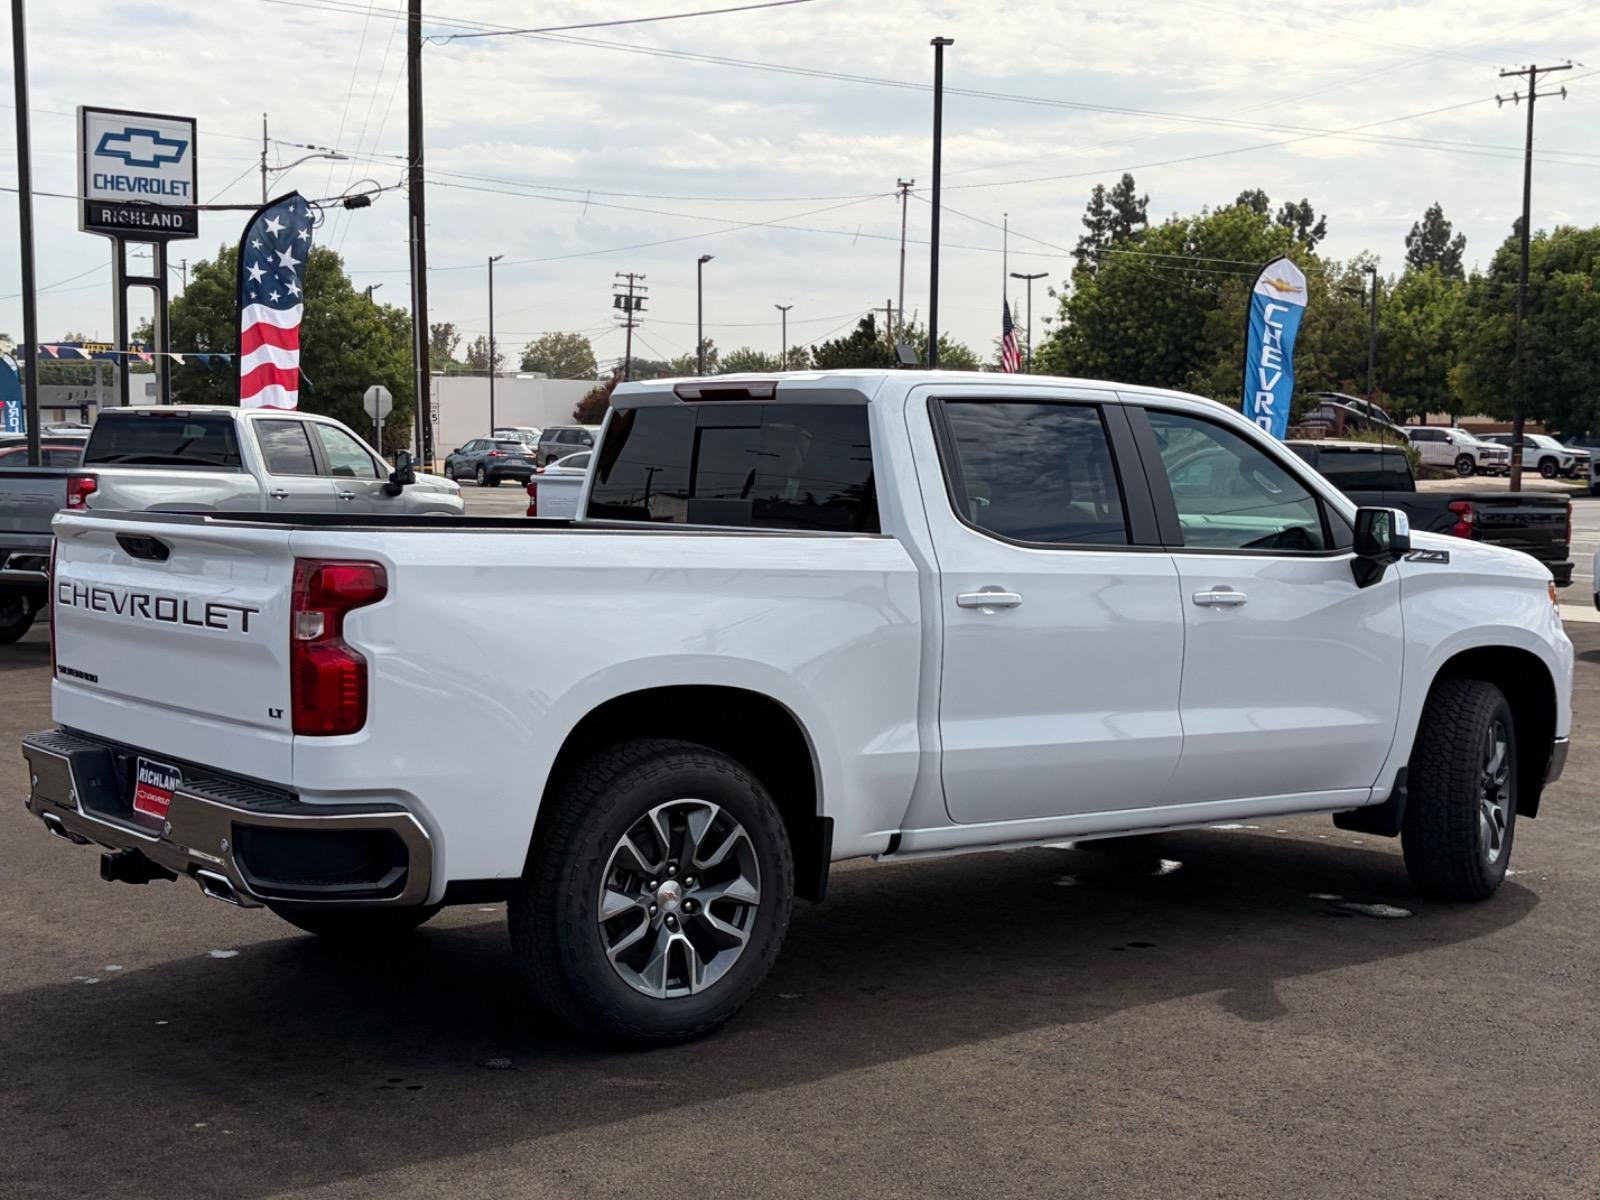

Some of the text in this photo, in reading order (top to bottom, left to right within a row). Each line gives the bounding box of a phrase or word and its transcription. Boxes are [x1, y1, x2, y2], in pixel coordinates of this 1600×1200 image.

[94, 173, 190, 196] CHEVROLET
[101, 209, 183, 228] RICHLAND
[58, 582, 260, 632] CHEVROLET
[268, 707, 284, 719] LT
